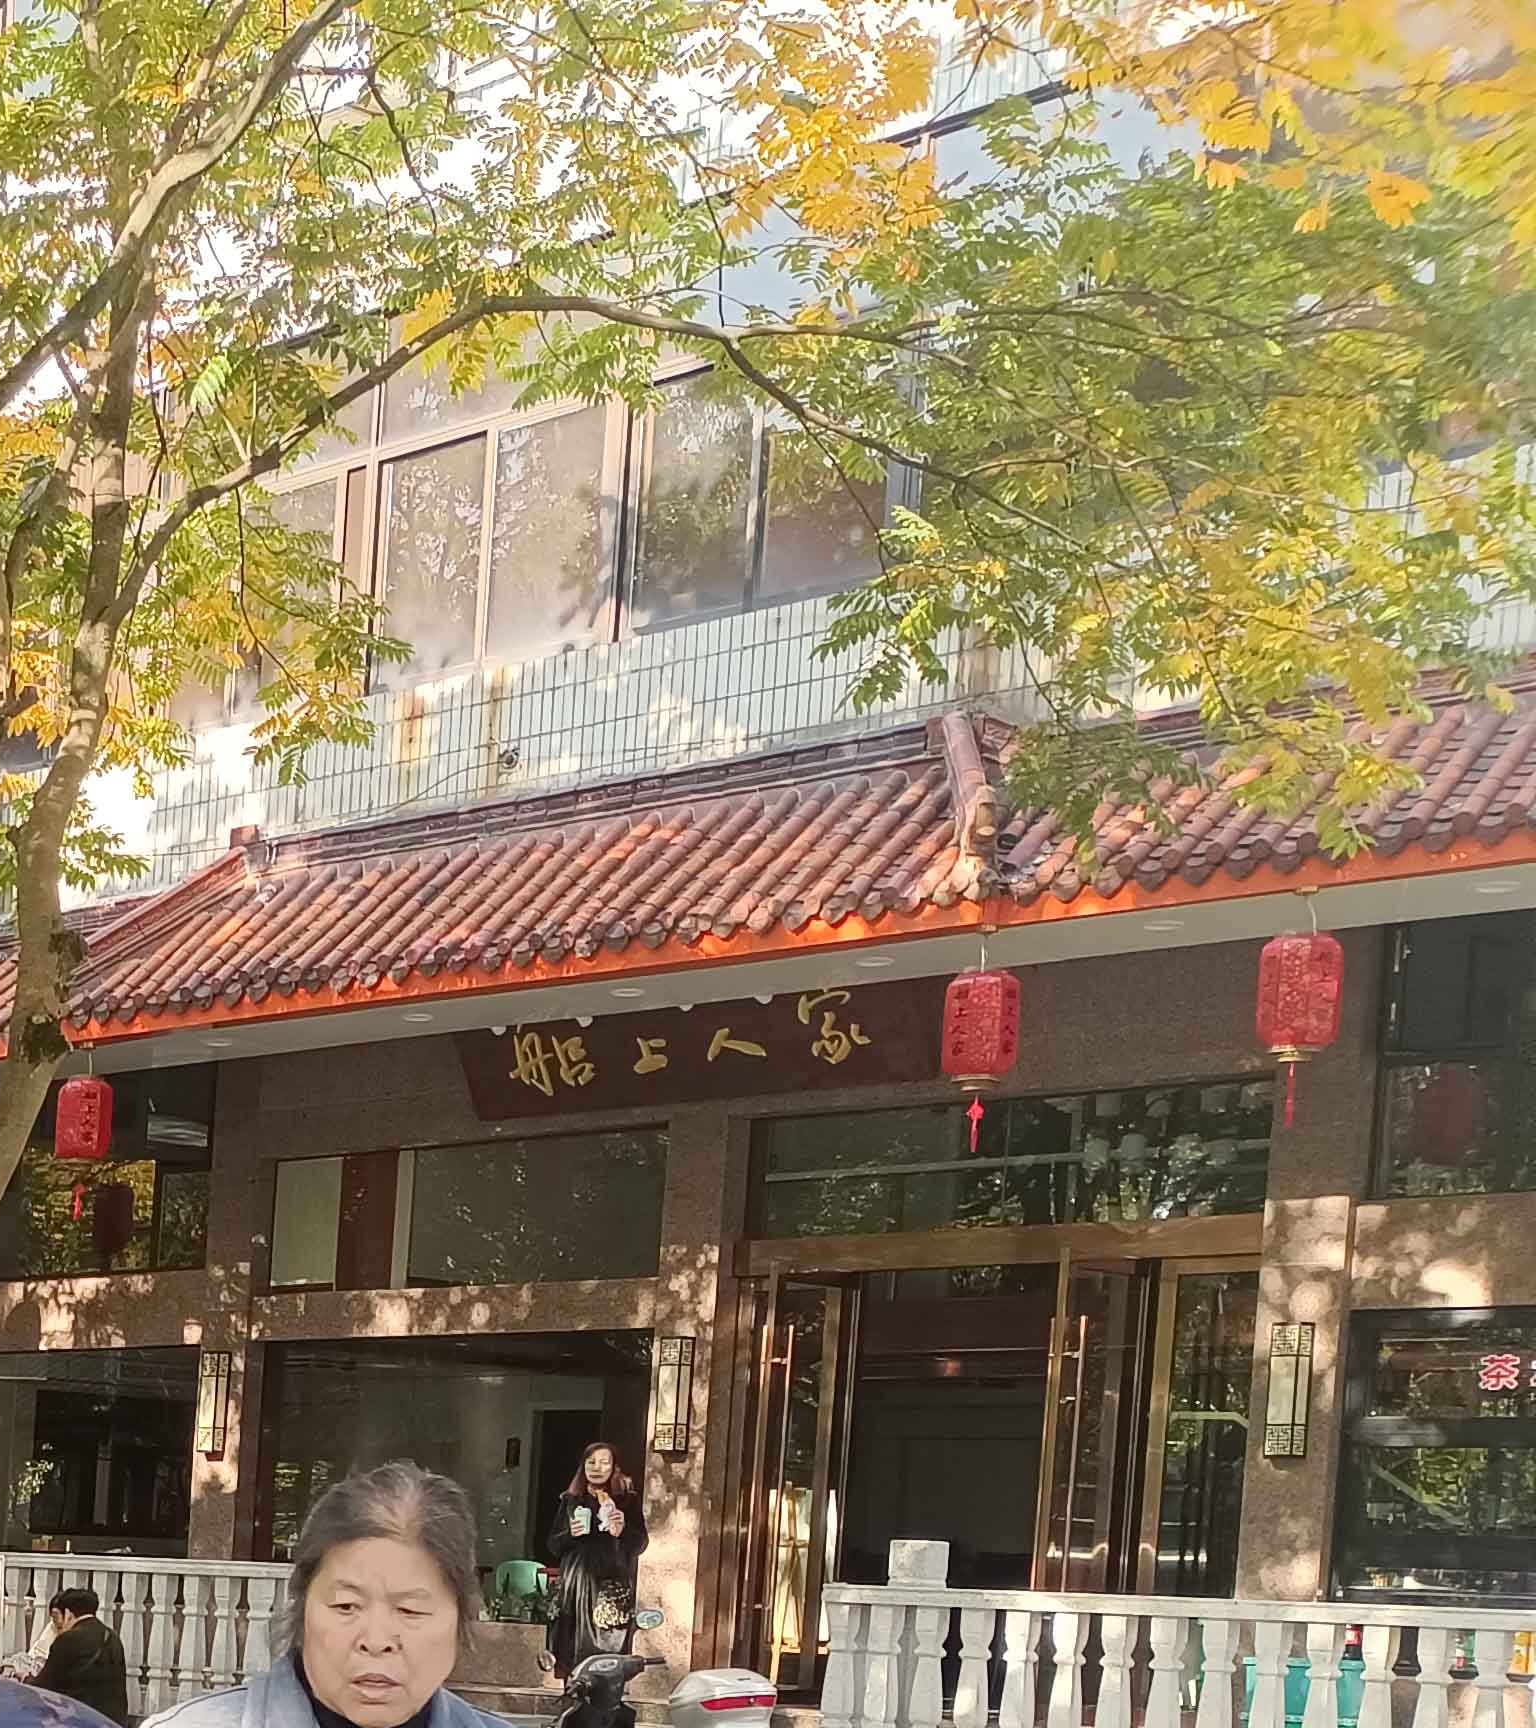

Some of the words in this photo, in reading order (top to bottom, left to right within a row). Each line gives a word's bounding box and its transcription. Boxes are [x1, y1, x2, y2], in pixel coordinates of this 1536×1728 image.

[509, 989, 871, 1096] 船上人家
[1478, 1354, 1536, 1390] 茶
